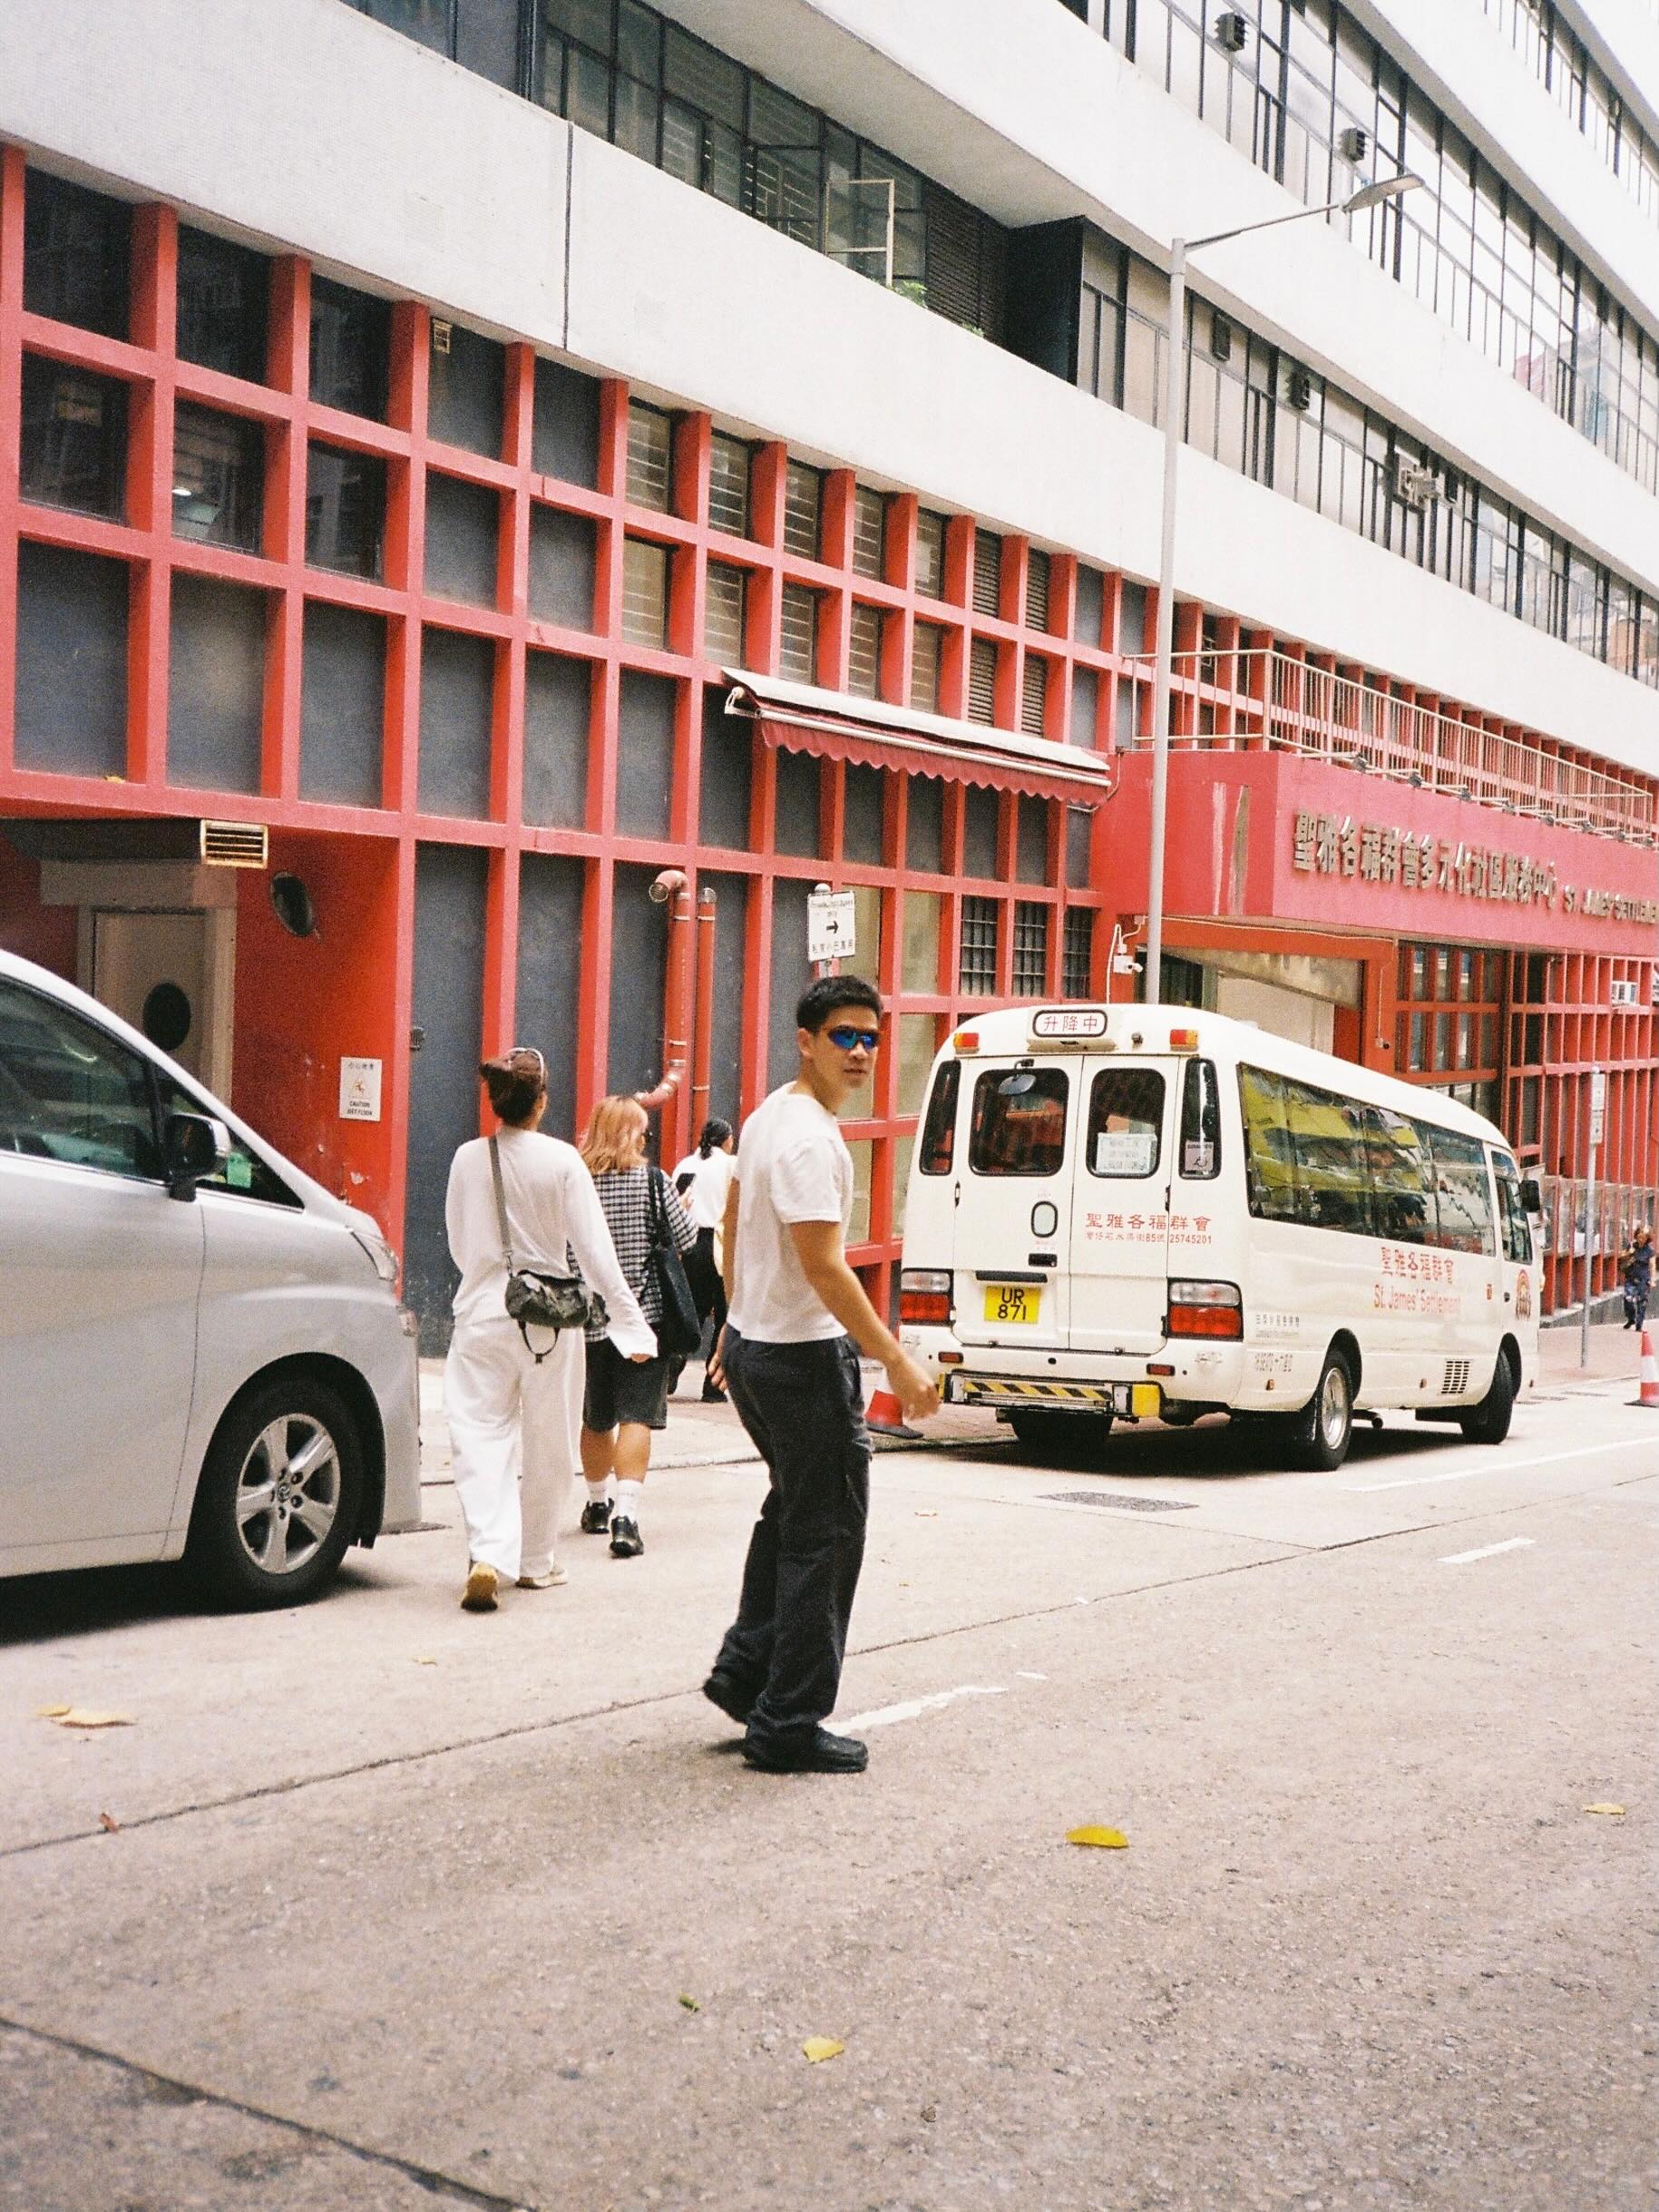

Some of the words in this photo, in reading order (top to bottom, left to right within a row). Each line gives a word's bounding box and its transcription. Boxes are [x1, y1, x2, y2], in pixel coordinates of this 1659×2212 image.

[1044, 1015, 1097, 1032] 升降中
[1086, 1213, 1211, 1231] 聖雅各福群會
[1170, 1234, 1212, 1244] 25745201
[1381, 1247, 1453, 1285] 聖雅各福群會
[1001, 1287, 1024, 1305] UR
[998, 1304, 1027, 1321] 871
